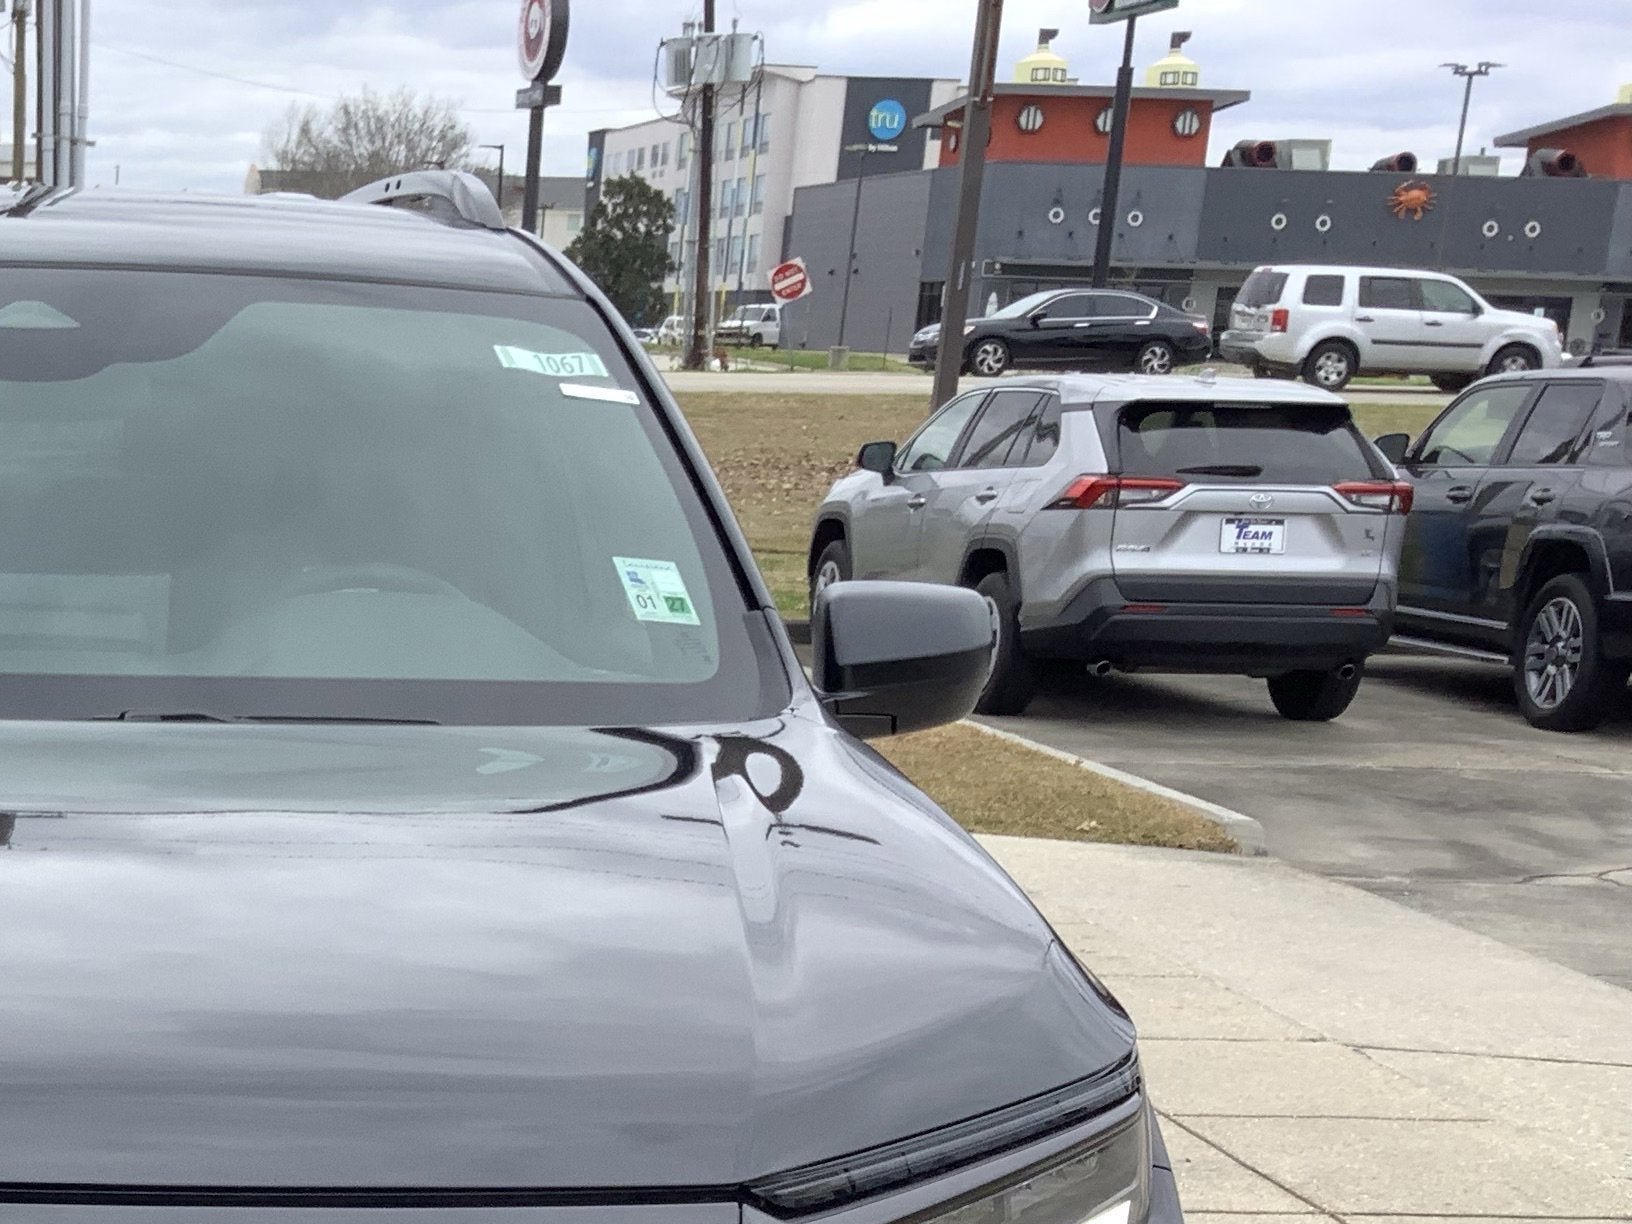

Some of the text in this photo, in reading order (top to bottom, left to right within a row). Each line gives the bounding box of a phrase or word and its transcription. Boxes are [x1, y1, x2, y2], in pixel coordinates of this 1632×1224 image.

[870, 107, 900, 129] tru
[532, 353, 585, 374] 1067
[1235, 519, 1273, 540] TEAM
[636, 594, 657, 610] 01
